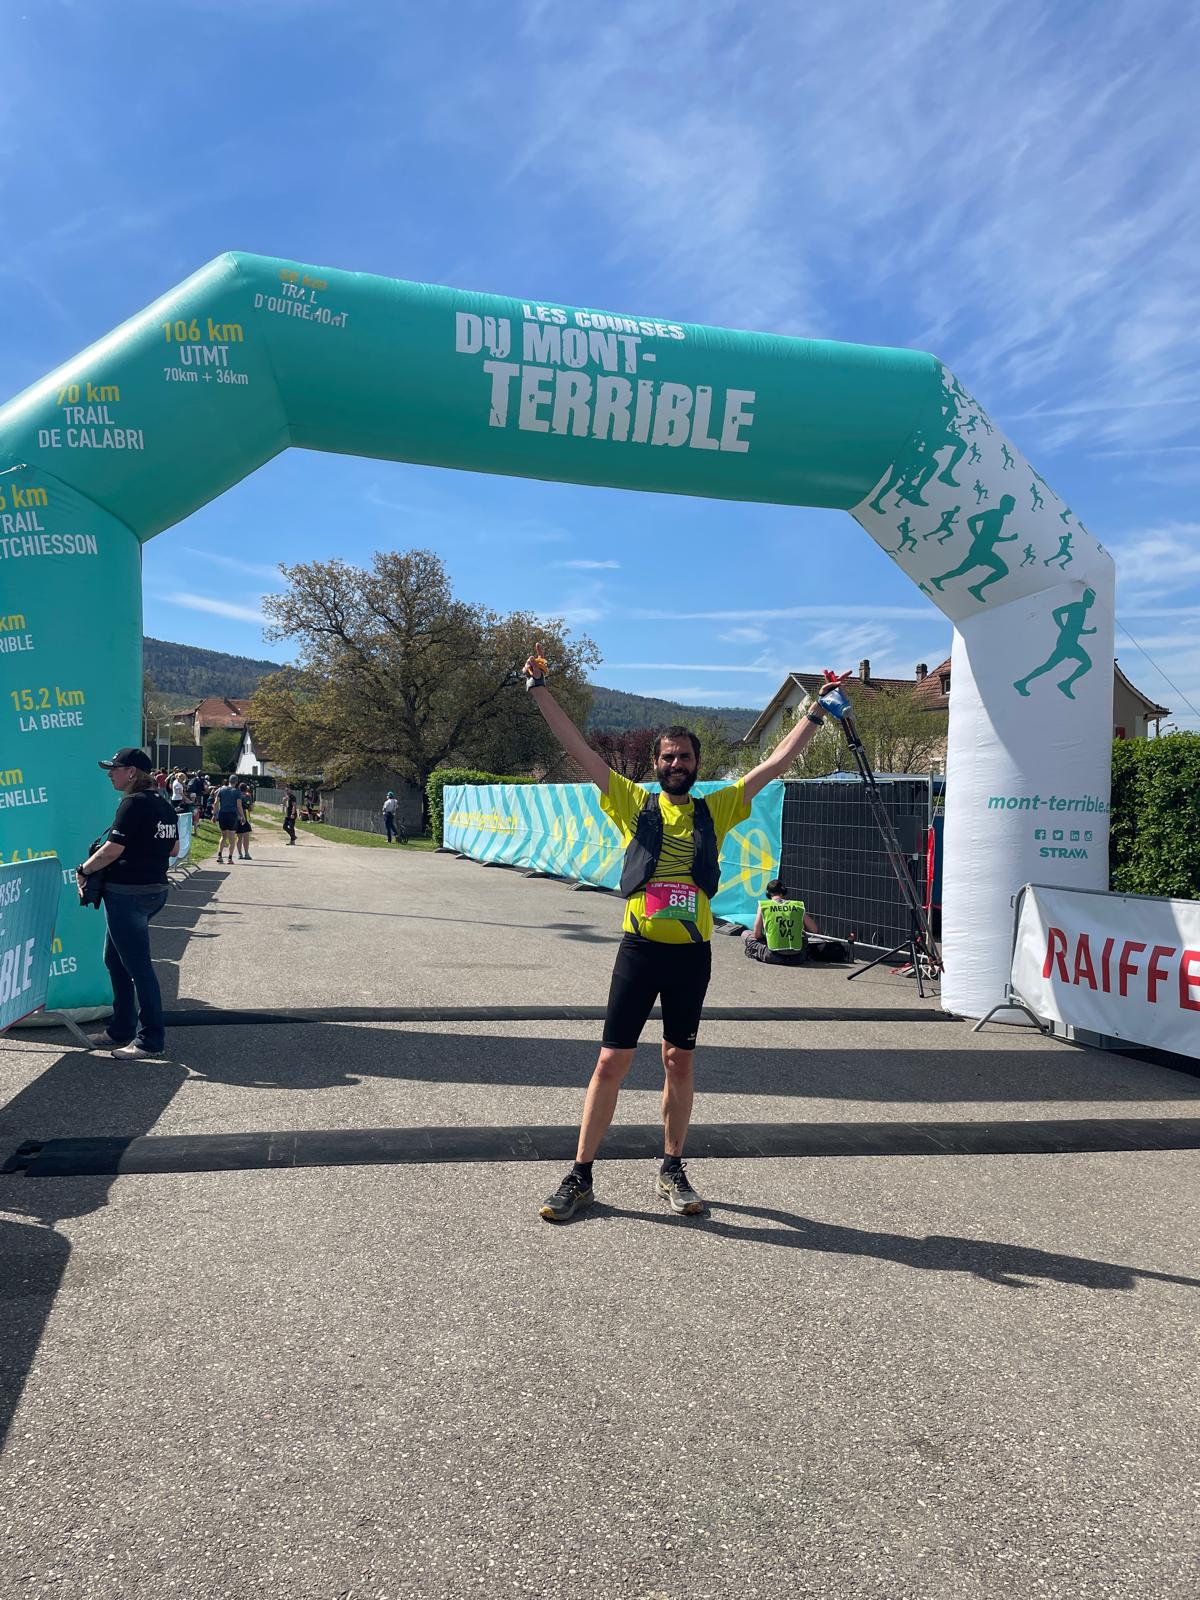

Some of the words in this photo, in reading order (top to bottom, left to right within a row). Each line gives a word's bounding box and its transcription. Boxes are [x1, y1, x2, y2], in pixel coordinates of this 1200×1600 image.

[162, 319, 201, 343] 106
[207, 318, 244, 343] km
[522, 304, 567, 325] LES
[574, 311, 686, 340] COURSES
[455, 311, 511, 358] DU
[522, 322, 657, 374] MONT-
[179, 345, 229, 366] UTMT
[164, 367, 198, 382] 70km
[202, 373, 213, 384] +
[216, 369, 249, 385] 36km
[55, 384, 80, 405] 70
[87, 382, 120, 403] km
[63, 406, 115, 425] TRAIL
[483, 360, 756, 453] TERRIBLE
[38, 429, 62, 449] DE
[66, 428, 144, 450] CALABRI
[11, 483, 48, 508] km
[0, 511, 45, 535] RAIL
[0, 535, 98, 560] TCHIESSON
[10, 687, 51, 711] 15,2
[55, 686, 85, 706] km
[19, 715, 38, 732] LA
[40, 709, 84, 730] BRÈRE
[1039, 847, 1089, 859] STRAVA
[669, 893, 687, 908] 83
[779, 919, 794, 928] KU
[49, 956, 78, 977] LES
[1042, 927, 1200, 1011] RAIFFE
